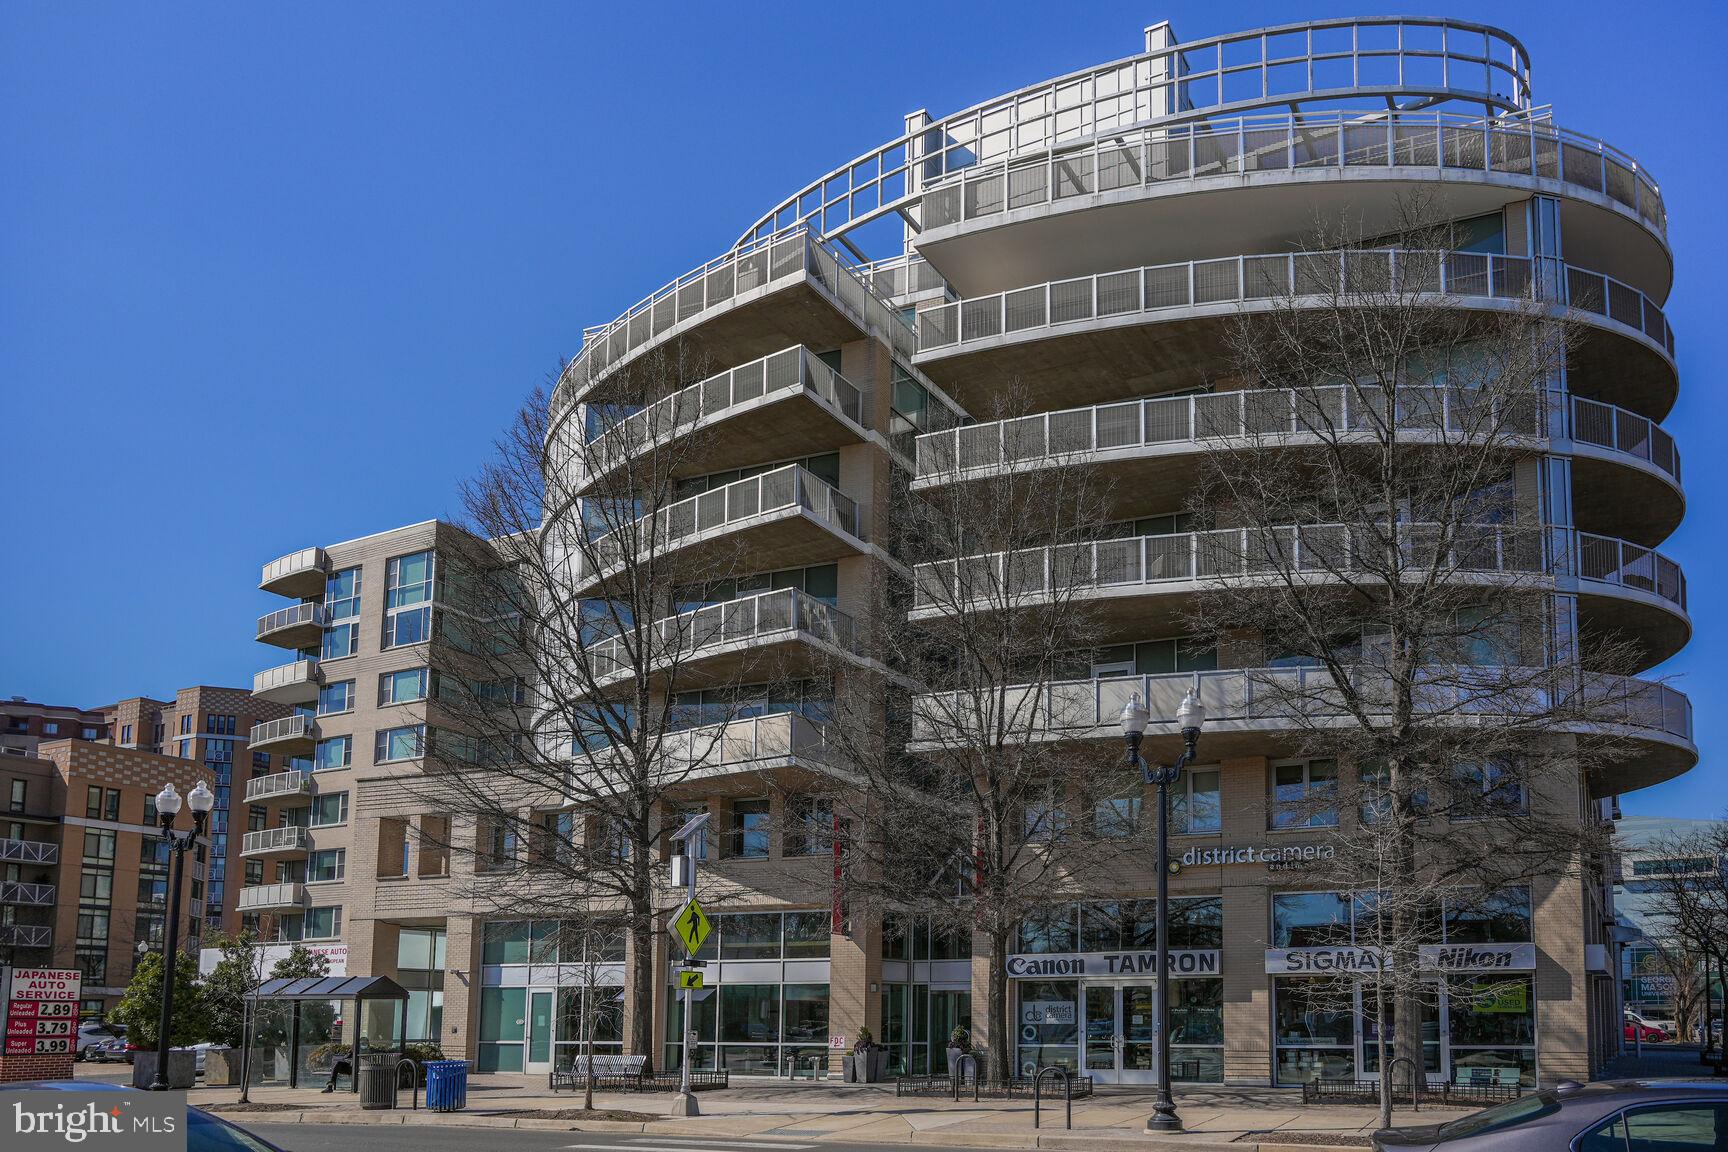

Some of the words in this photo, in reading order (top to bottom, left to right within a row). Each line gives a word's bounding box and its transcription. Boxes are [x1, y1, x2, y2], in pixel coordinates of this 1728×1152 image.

[1183, 846, 1255, 866] district
[1259, 845, 1335, 862] camera
[1007, 957, 1085, 975] Canon
[1104, 953, 1215, 974] TAMRON
[1286, 951, 1377, 970] SIGMA
[1437, 948, 1513, 968] Nikon
[15, 970, 80, 980] JAPANESE
[28, 981, 66, 989] AUTO
[16, 990, 75, 999] SERVICE
[40, 1004, 70, 1016] 2.89
[37, 1022, 68, 1034] 3.79
[36, 1040, 67, 1052] 3.99
